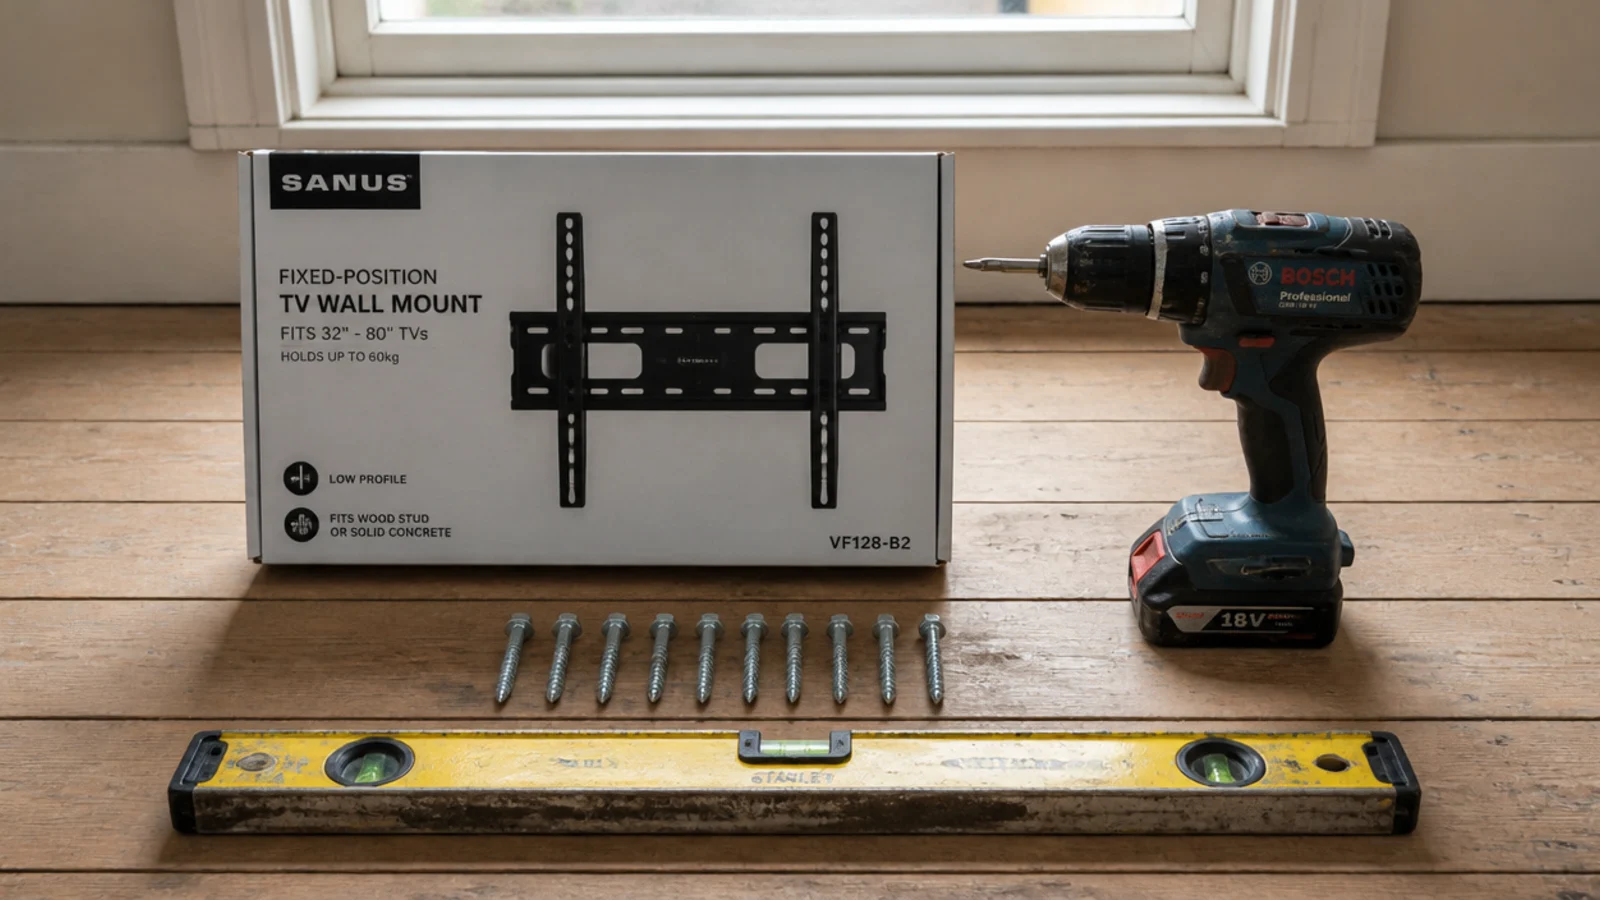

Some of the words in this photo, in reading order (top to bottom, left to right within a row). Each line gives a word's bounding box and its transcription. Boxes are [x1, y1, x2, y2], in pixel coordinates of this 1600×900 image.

[279, 268, 437, 285] FIXED-POSITION
[1280, 267, 1355, 286] BOSCH
[279, 294, 310, 313] TV
[317, 294, 384, 313] WALL
[392, 294, 482, 313] MOUNT
[1280, 291, 1351, 303] Professional
[280, 326, 316, 341] FITS
[321, 326, 349, 341] 32"
[365, 326, 394, 341] 80"
[399, 326, 429, 341] TVs
[280, 350, 324, 363] HOLDS
[327, 350, 345, 363] UP
[347, 350, 366, 363] TO
[368, 350, 400, 366] 60kg
[329, 474, 356, 485] LOW
[359, 474, 407, 485] PROFILE
[329, 513, 355, 524] FITS
[357, 513, 396, 524] WOOD
[398, 513, 430, 524] STUD
[330, 527, 348, 538] OR
[350, 527, 386, 538] SOLID
[388, 527, 452, 538] CONCRETE
[829, 535, 911, 550] VF128-B2
[1221, 612, 1267, 628] 18V
